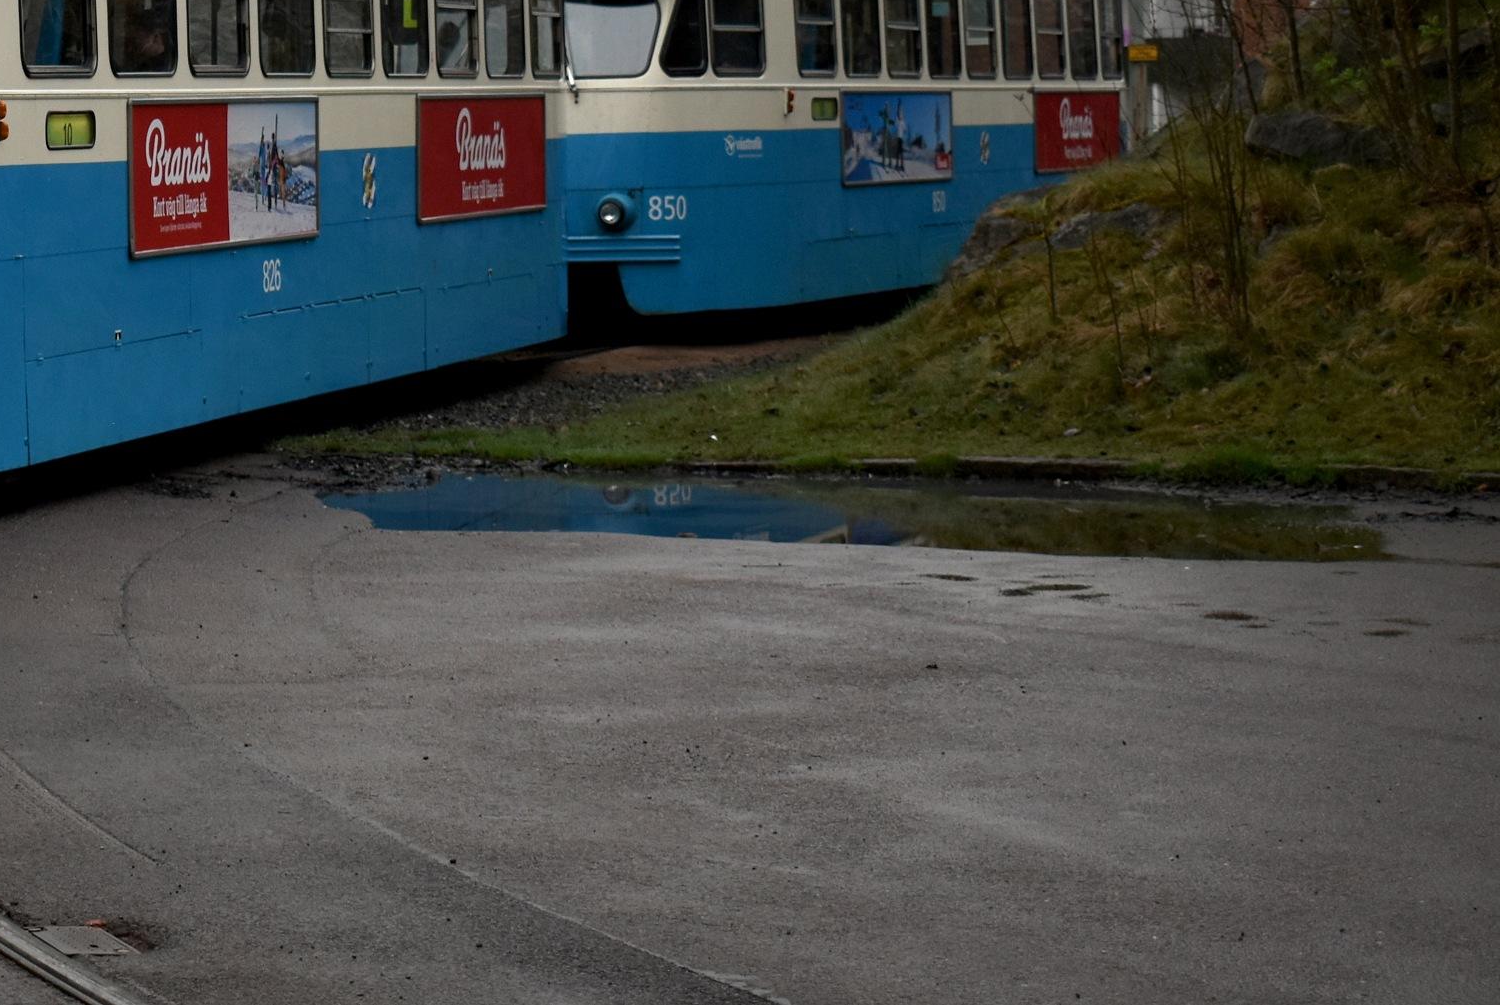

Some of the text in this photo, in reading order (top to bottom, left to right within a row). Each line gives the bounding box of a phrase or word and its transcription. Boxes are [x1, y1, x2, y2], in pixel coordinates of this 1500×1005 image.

[63, 123, 73, 146] 10
[456, 108, 506, 170] Branäs
[145, 118, 211, 186] Branäs
[153, 196, 165, 217] Kort
[176, 194, 184, 215] till
[648, 195, 687, 220] 850
[262, 258, 281, 292] 826
